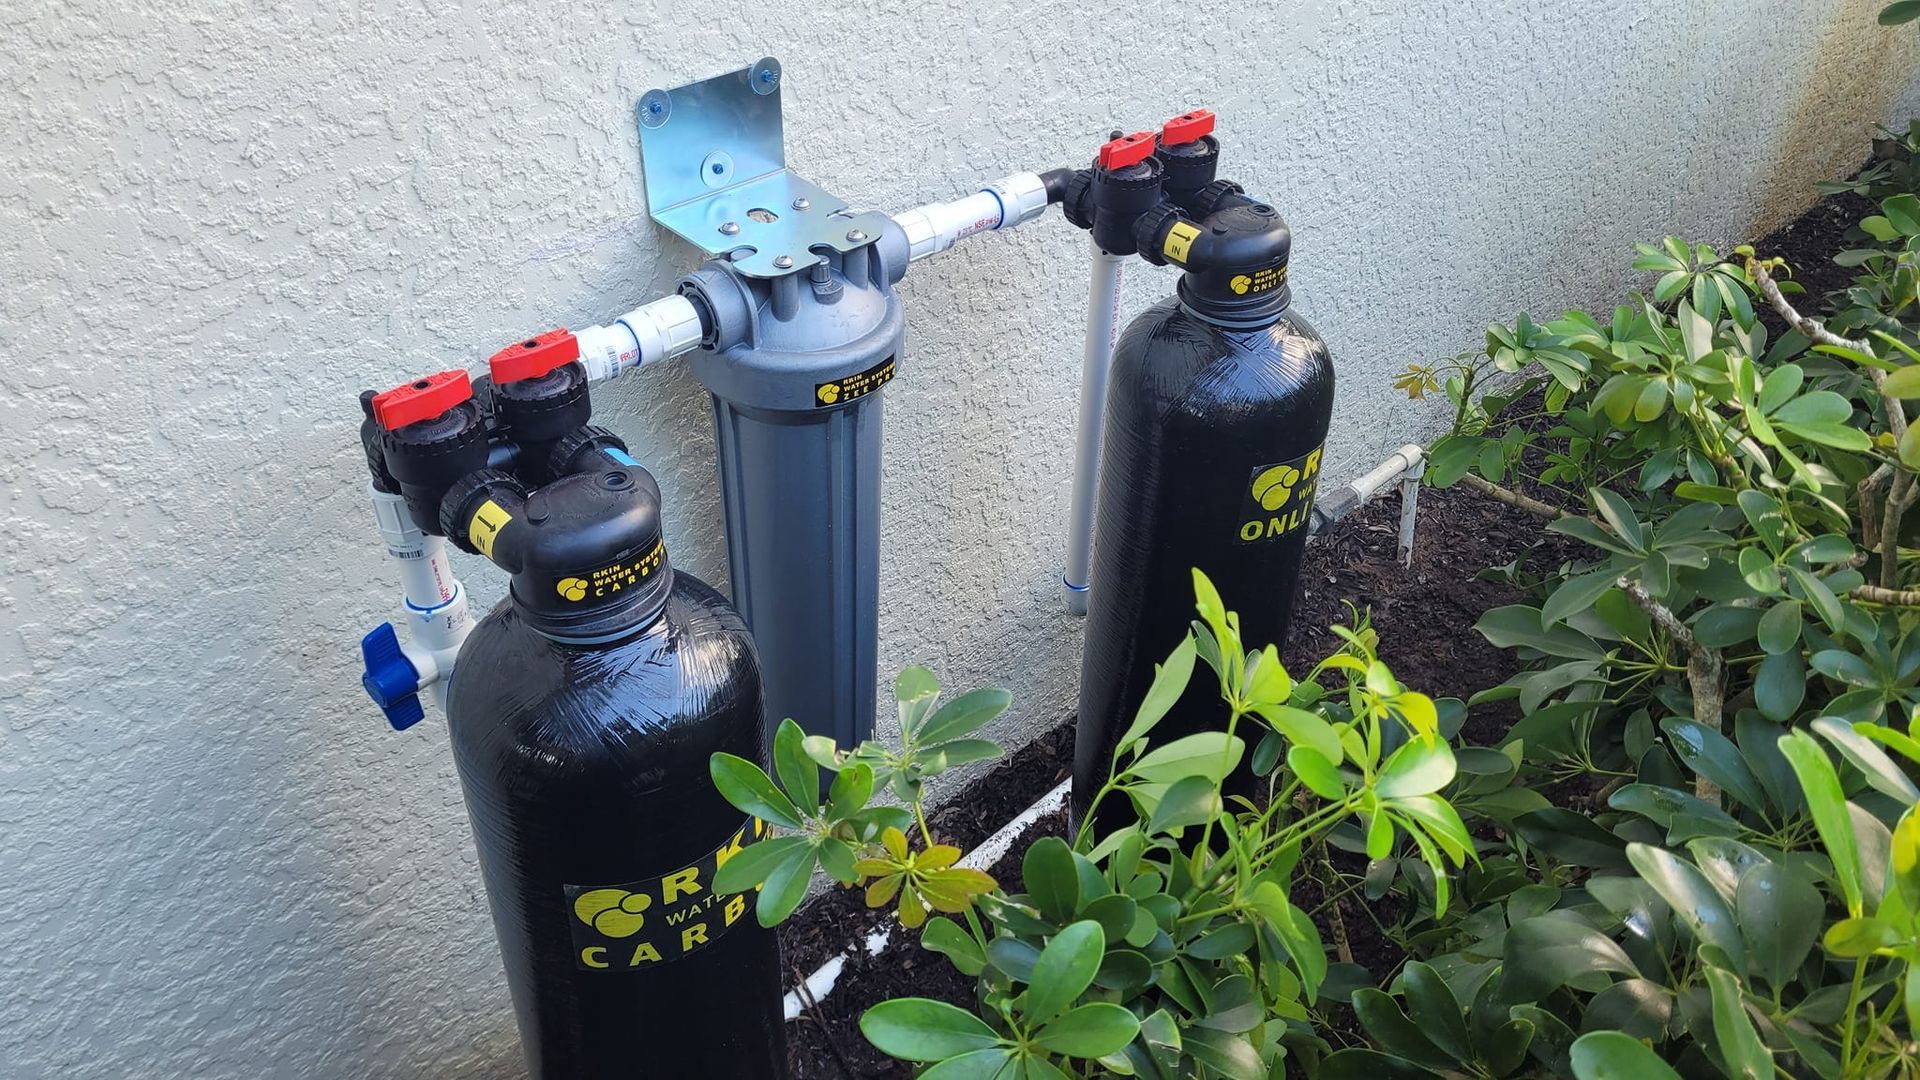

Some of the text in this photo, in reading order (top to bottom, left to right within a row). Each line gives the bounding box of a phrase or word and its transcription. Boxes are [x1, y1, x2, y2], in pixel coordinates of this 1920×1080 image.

[1171, 244, 1181, 256] IN
[1254, 272, 1277, 284] WATER
[1255, 268, 1273, 278] RKIN
[843, 373, 863, 385] RKIN
[843, 378, 870, 392] WATER
[843, 385, 869, 401] ZEE
[476, 534, 486, 550] IN
[592, 564, 621, 579] RKIN
[594, 567, 632, 587] WATER
[580, 881, 764, 969] CARB
